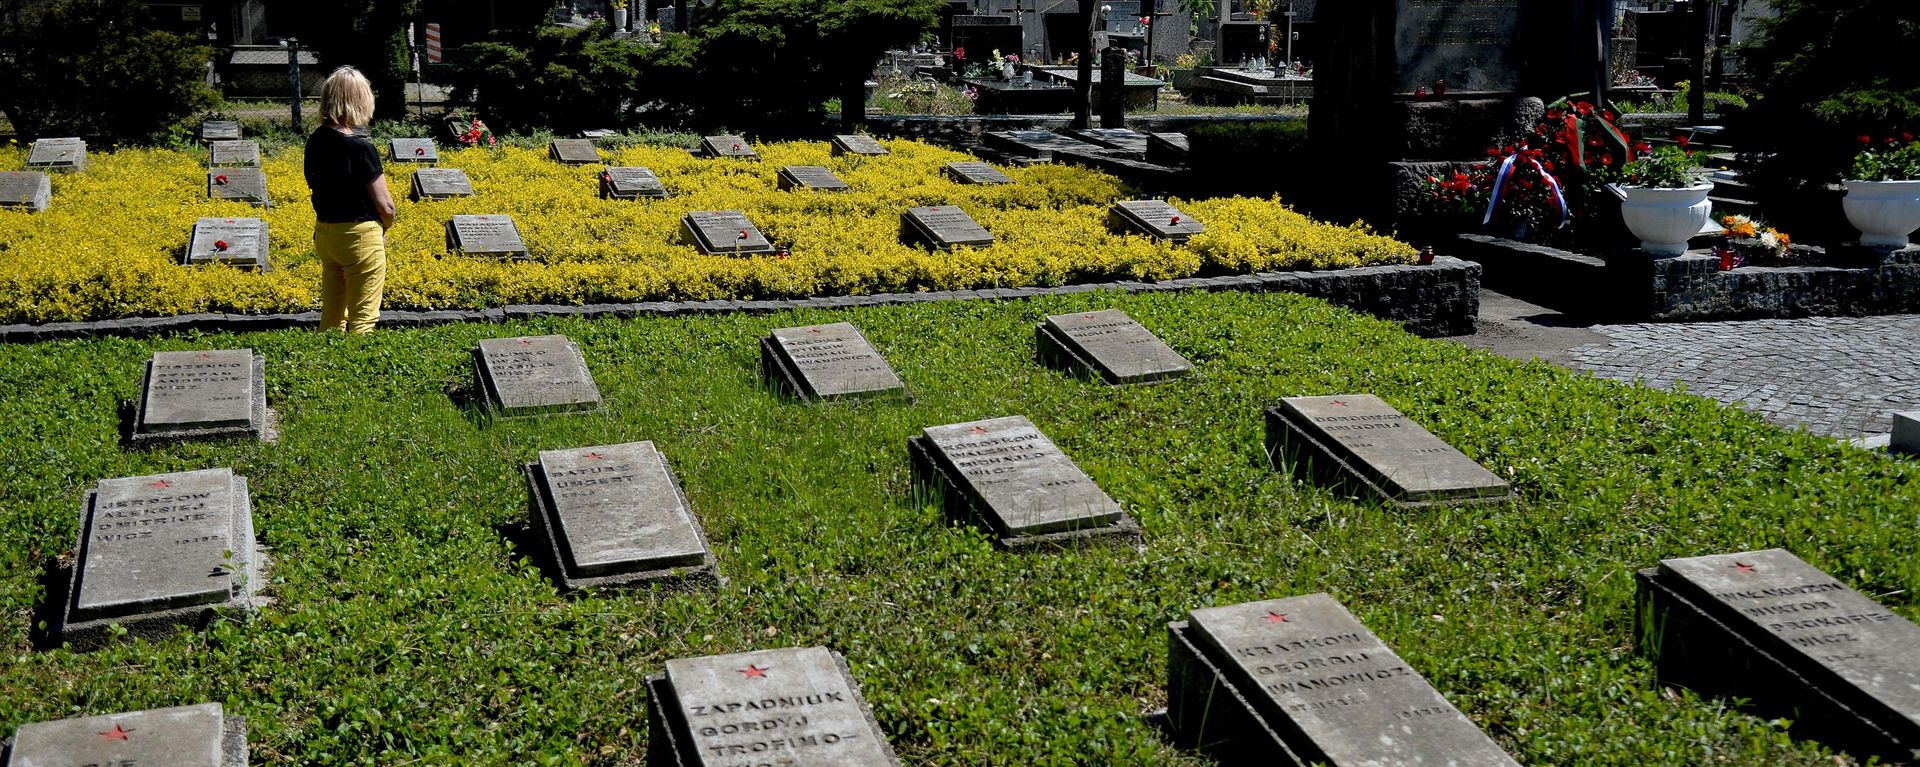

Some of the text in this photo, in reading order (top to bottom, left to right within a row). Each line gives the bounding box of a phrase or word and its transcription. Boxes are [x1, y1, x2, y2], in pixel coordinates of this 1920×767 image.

[97, 531, 153, 543] WICZ
[1745, 601, 1835, 617] WIKTOR
[1792, 633, 1858, 647] WICZ
[1257, 653, 1370, 676] GEORGIJ
[1268, 667, 1411, 695] IWANOWICZ
[691, 690, 845, 716] ZAPADNIUK
[700, 716, 809, 737] GORDYJ
[709, 733, 858, 758] TROFIMO-
